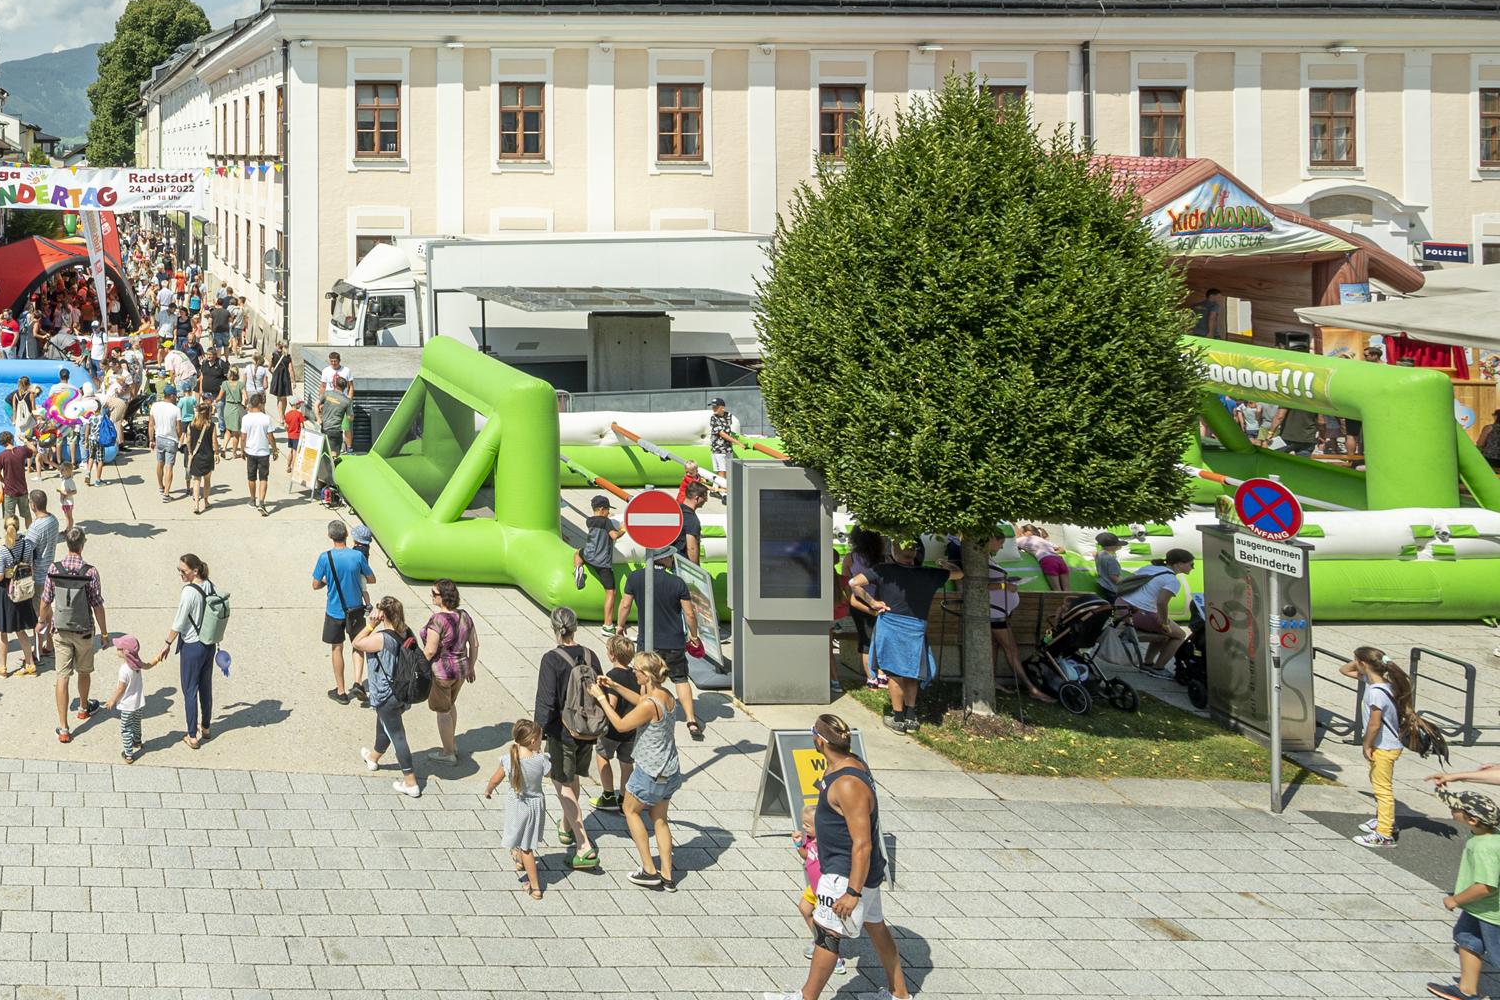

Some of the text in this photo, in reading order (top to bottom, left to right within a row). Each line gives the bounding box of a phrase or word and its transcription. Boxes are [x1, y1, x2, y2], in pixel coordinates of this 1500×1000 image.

[128, 172, 194, 183] Radstadt
[129, 185, 195, 193] 24. Juli 2022
[1425, 248, 1463, 257] POLIZEI
[1247, 524, 1290, 540] ANFANG
[1235, 537, 1301, 560] ausgenommen
[1239, 550, 1297, 574] Behinderte
[810, 758, 829, 771] W
[817, 894, 837, 908] HO
